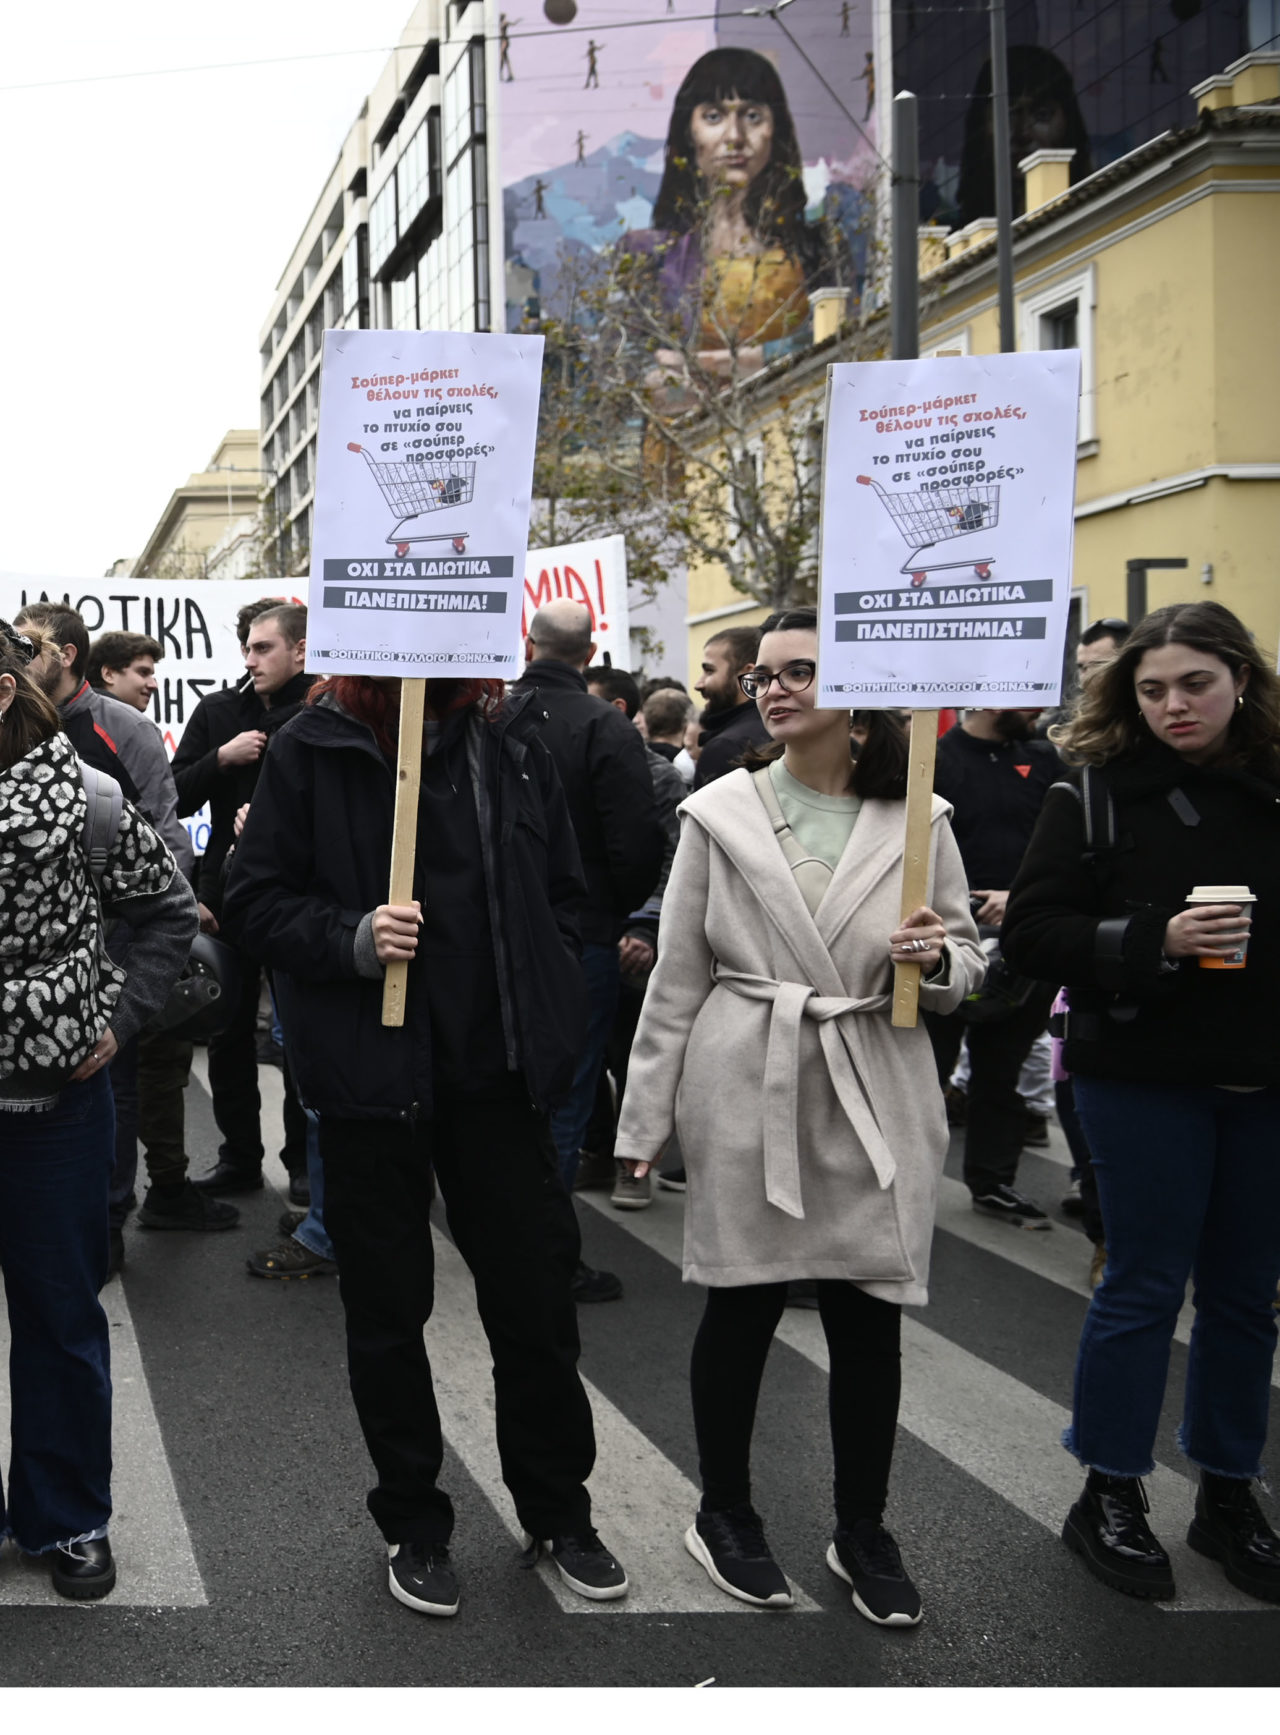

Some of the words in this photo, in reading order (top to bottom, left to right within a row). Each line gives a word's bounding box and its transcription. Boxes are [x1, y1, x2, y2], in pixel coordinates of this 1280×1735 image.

[351, 368, 460, 389] Σούπερ-μάρκετ
[366, 388, 419, 402] θέλουν
[424, 387, 442, 400] τις
[447, 383, 498, 399] σχολές,
[393, 407, 411, 419] να
[416, 402, 473, 418] παίρνεις
[859, 393, 977, 422] Σούπερ-μάρκετ
[363, 422, 379, 433] το
[384, 419, 431, 433] πτυχίο
[435, 421, 462, 432] σου
[876, 416, 932, 434] θέλουν
[938, 415, 958, 428] τις
[963, 405, 1027, 423] σχολές,
[380, 440, 398, 452] σε
[404, 434, 465, 450] «σούπερ
[905, 438, 924, 450] να
[930, 426, 996, 446] παίρνεις
[873, 454, 890, 465] το
[895, 448, 946, 464] πτυχίο
[951, 446, 982, 458] σου
[892, 470, 911, 482] σε
[917, 460, 986, 478] «σούπερ
[347, 562, 378, 577] ΟΧΙ
[384, 562, 416, 576] ΣΤΑ
[422, 560, 490, 576] ΙΔΙΩΤΙΚΑ
[344, 590, 488, 610] ΠΑΝΕΠΙΣΤΗΜΙΑ!
[859, 594, 892, 609] ΟΧΙ
[898, 592, 934, 607] ΣΤΑ
[940, 586, 1025, 605] ΙΔΙΩΤΙΚΑ
[857, 621, 1023, 640] ΠΑΝΕΠΙΣΤΗΜΙΑ!
[328, 650, 394, 662] ΦΟΙΤΗΤΙΚΟΙ
[398, 652, 450, 663] ΣΥΛΛΟΓΟΙ
[451, 653, 496, 664] ΑΘΗΝΑΣ
[842, 682, 912, 693] ΦΟΙΤΗΤΙΚΟΙ
[915, 682, 977, 693] ΣΥΛΛΟΓΟΙ
[980, 682, 1034, 692] ΑΘΗΝΑΣ
